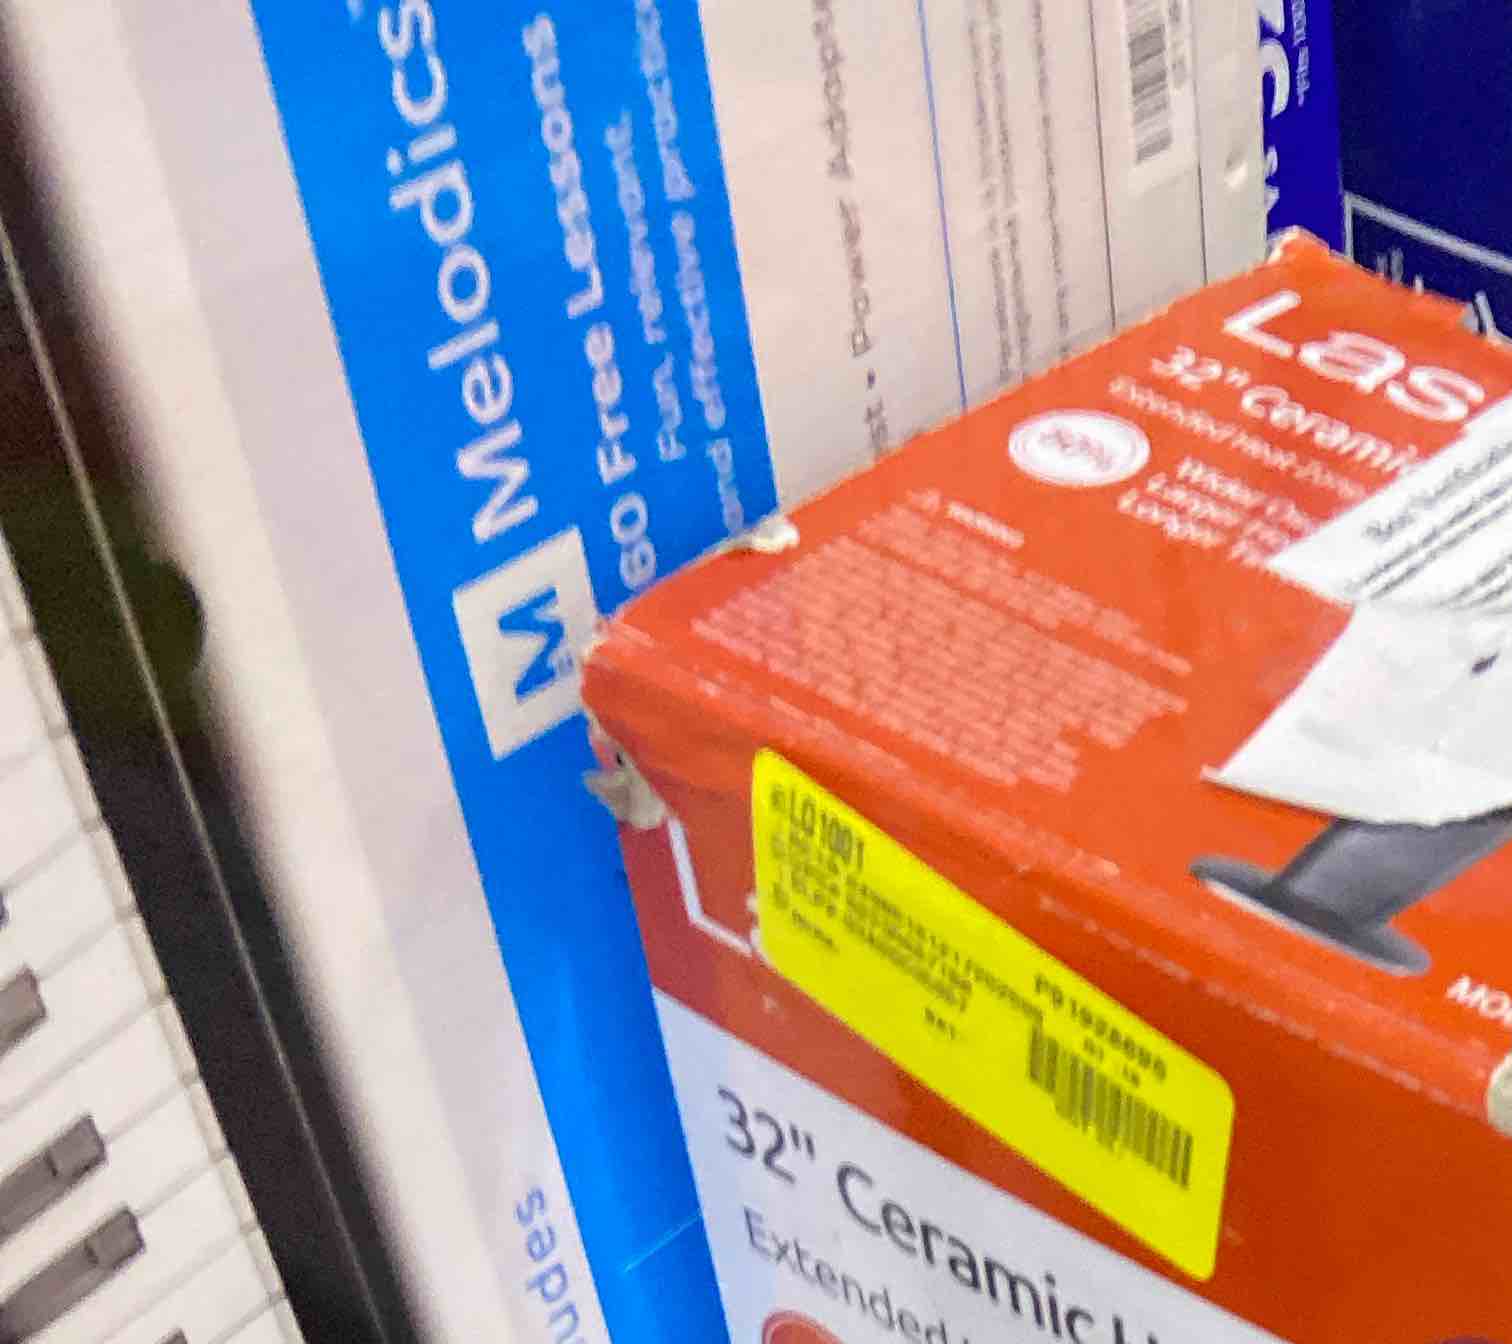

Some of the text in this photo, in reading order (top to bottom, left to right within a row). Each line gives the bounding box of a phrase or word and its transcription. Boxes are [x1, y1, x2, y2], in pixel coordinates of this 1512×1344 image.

[521, 12, 604, 320] Lessons
[378, 0, 541, 543] Melodics
[584, 321, 638, 485] Free
[1222, 288, 1485, 422] Las
[717, 1084, 816, 1184] 32"
